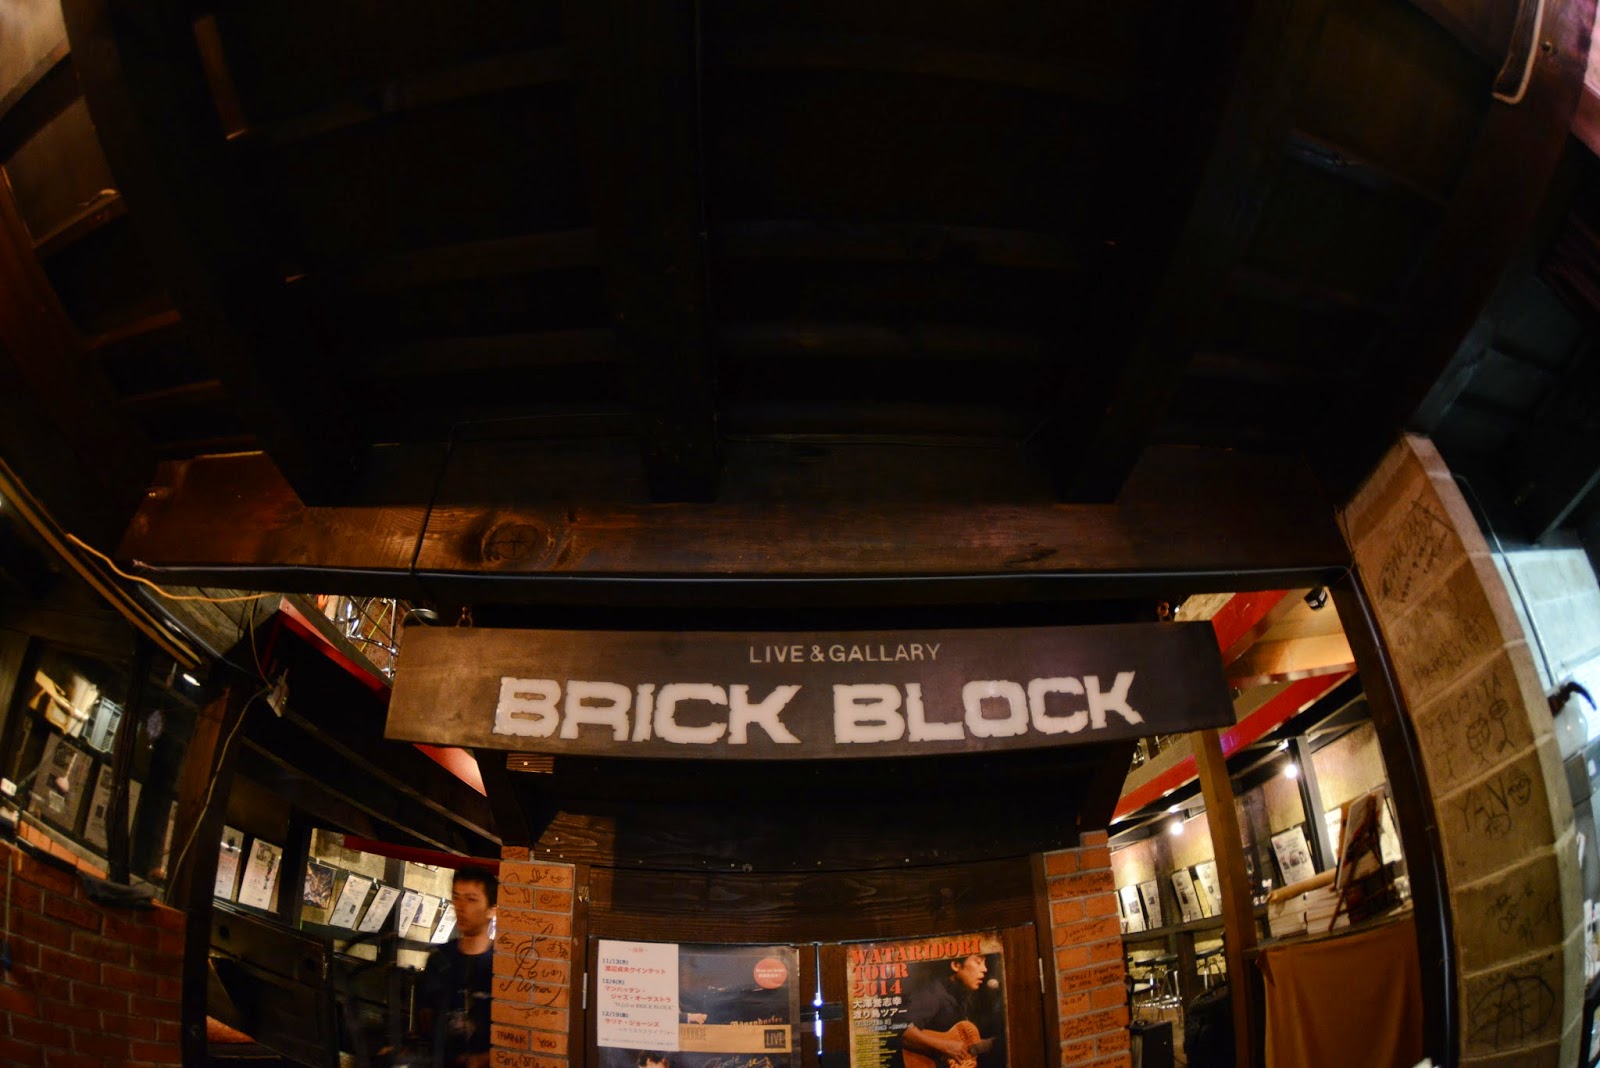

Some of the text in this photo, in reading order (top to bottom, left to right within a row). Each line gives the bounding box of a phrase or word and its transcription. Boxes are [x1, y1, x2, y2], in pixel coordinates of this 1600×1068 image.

[749, 645, 804, 663] LIVE
[828, 643, 941, 662] GALLARY
[493, 672, 1144, 744] BRICK BLOCK
[851, 940, 981, 965] WATARIDORI
[852, 963, 909, 981] TOUR
[852, 979, 902, 997] 2014
[537, 1037, 557, 1049] YOU
[766, 1031, 785, 1047] LIVE
